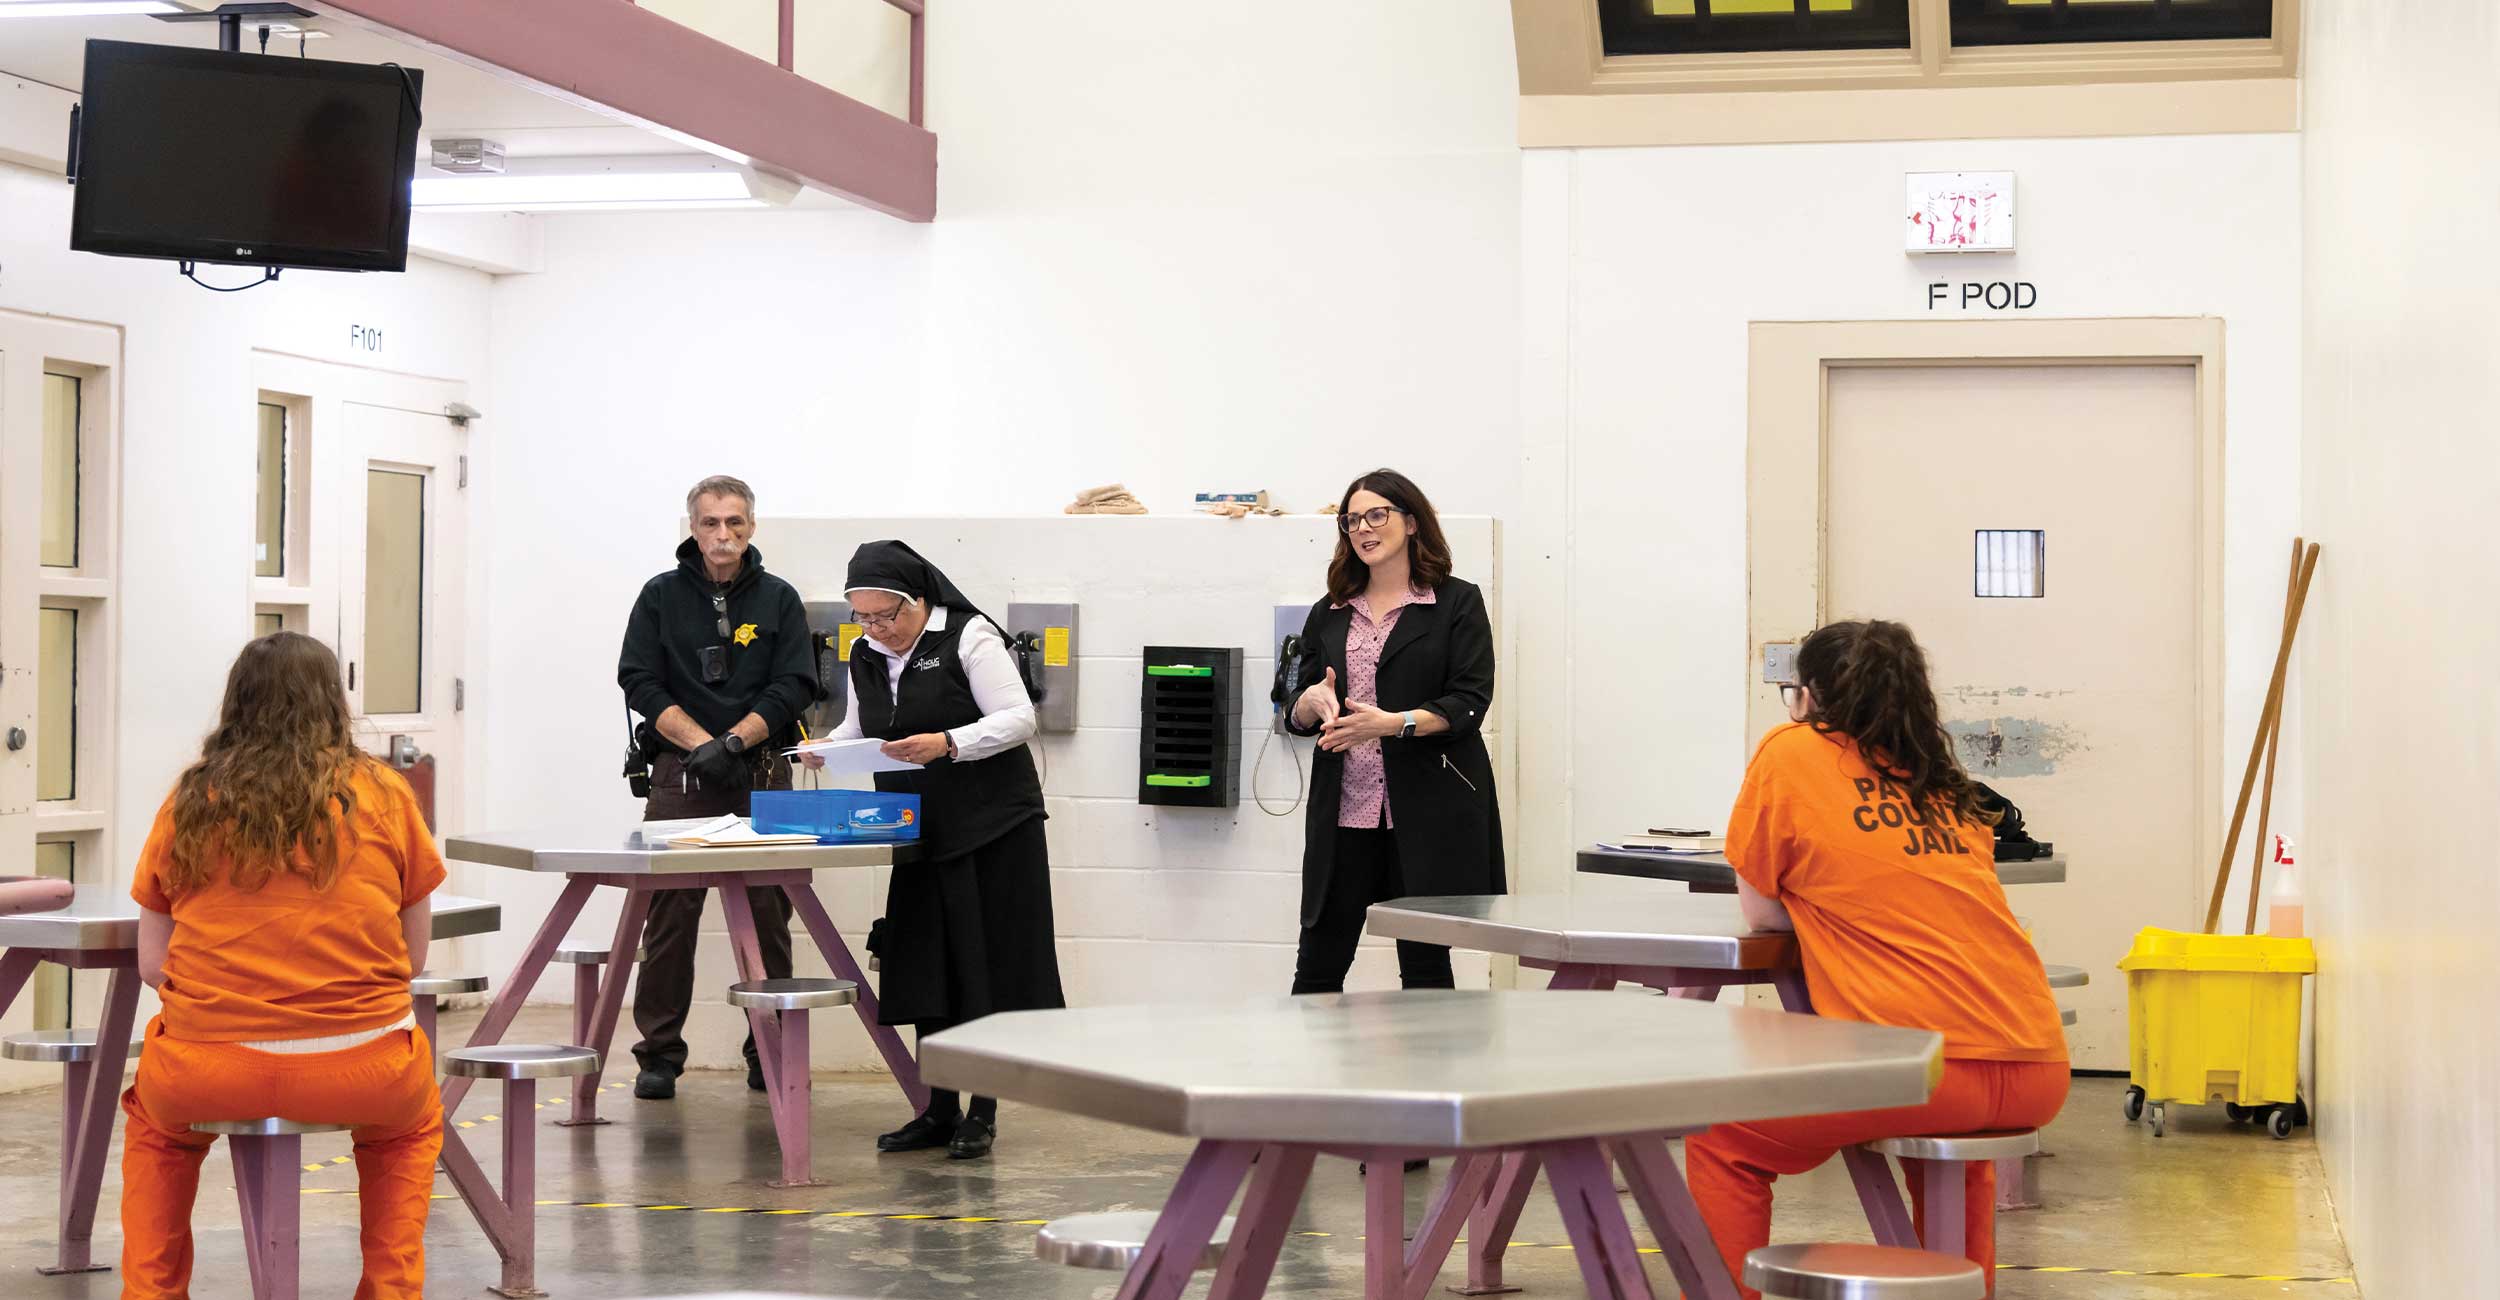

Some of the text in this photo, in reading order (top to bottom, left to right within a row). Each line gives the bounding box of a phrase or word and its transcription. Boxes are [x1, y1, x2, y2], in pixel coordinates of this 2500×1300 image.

[1928, 281, 2037, 310] F POD
[351, 323, 382, 353] F101
[1903, 827, 1970, 856] JAIL
